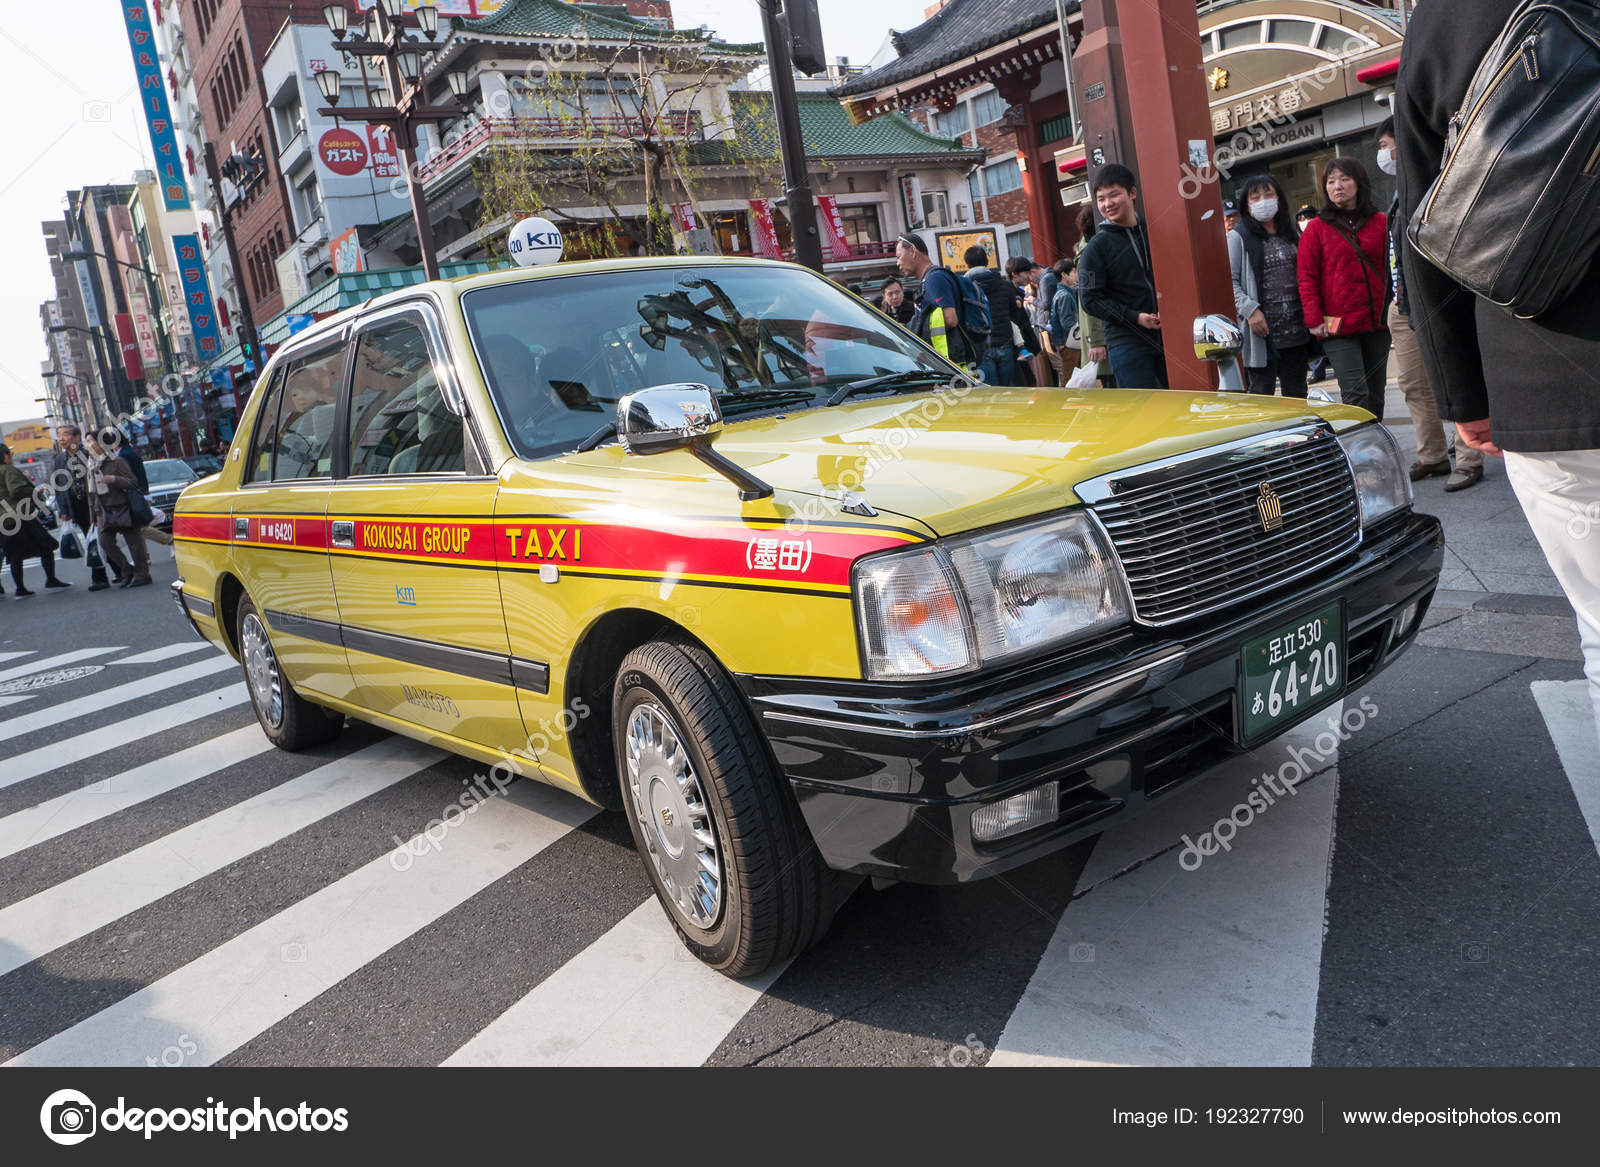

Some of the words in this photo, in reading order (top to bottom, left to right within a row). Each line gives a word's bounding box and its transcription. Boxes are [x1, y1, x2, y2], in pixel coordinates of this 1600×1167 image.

[1271, 124, 1315, 146] KOBAN
[326, 149, 364, 162] ガスト
[510, 240, 522, 253] 20
[180, 245, 217, 350] カラオケ館
[275, 523, 293, 541] 6420
[363, 525, 417, 551] KOKUSAI
[422, 527, 471, 554] GROUP
[505, 528, 582, 561] TAXI
[746, 537, 812, 573] (墨田)
[396, 584, 415, 601] km
[1268, 641, 1337, 717] 64-20
